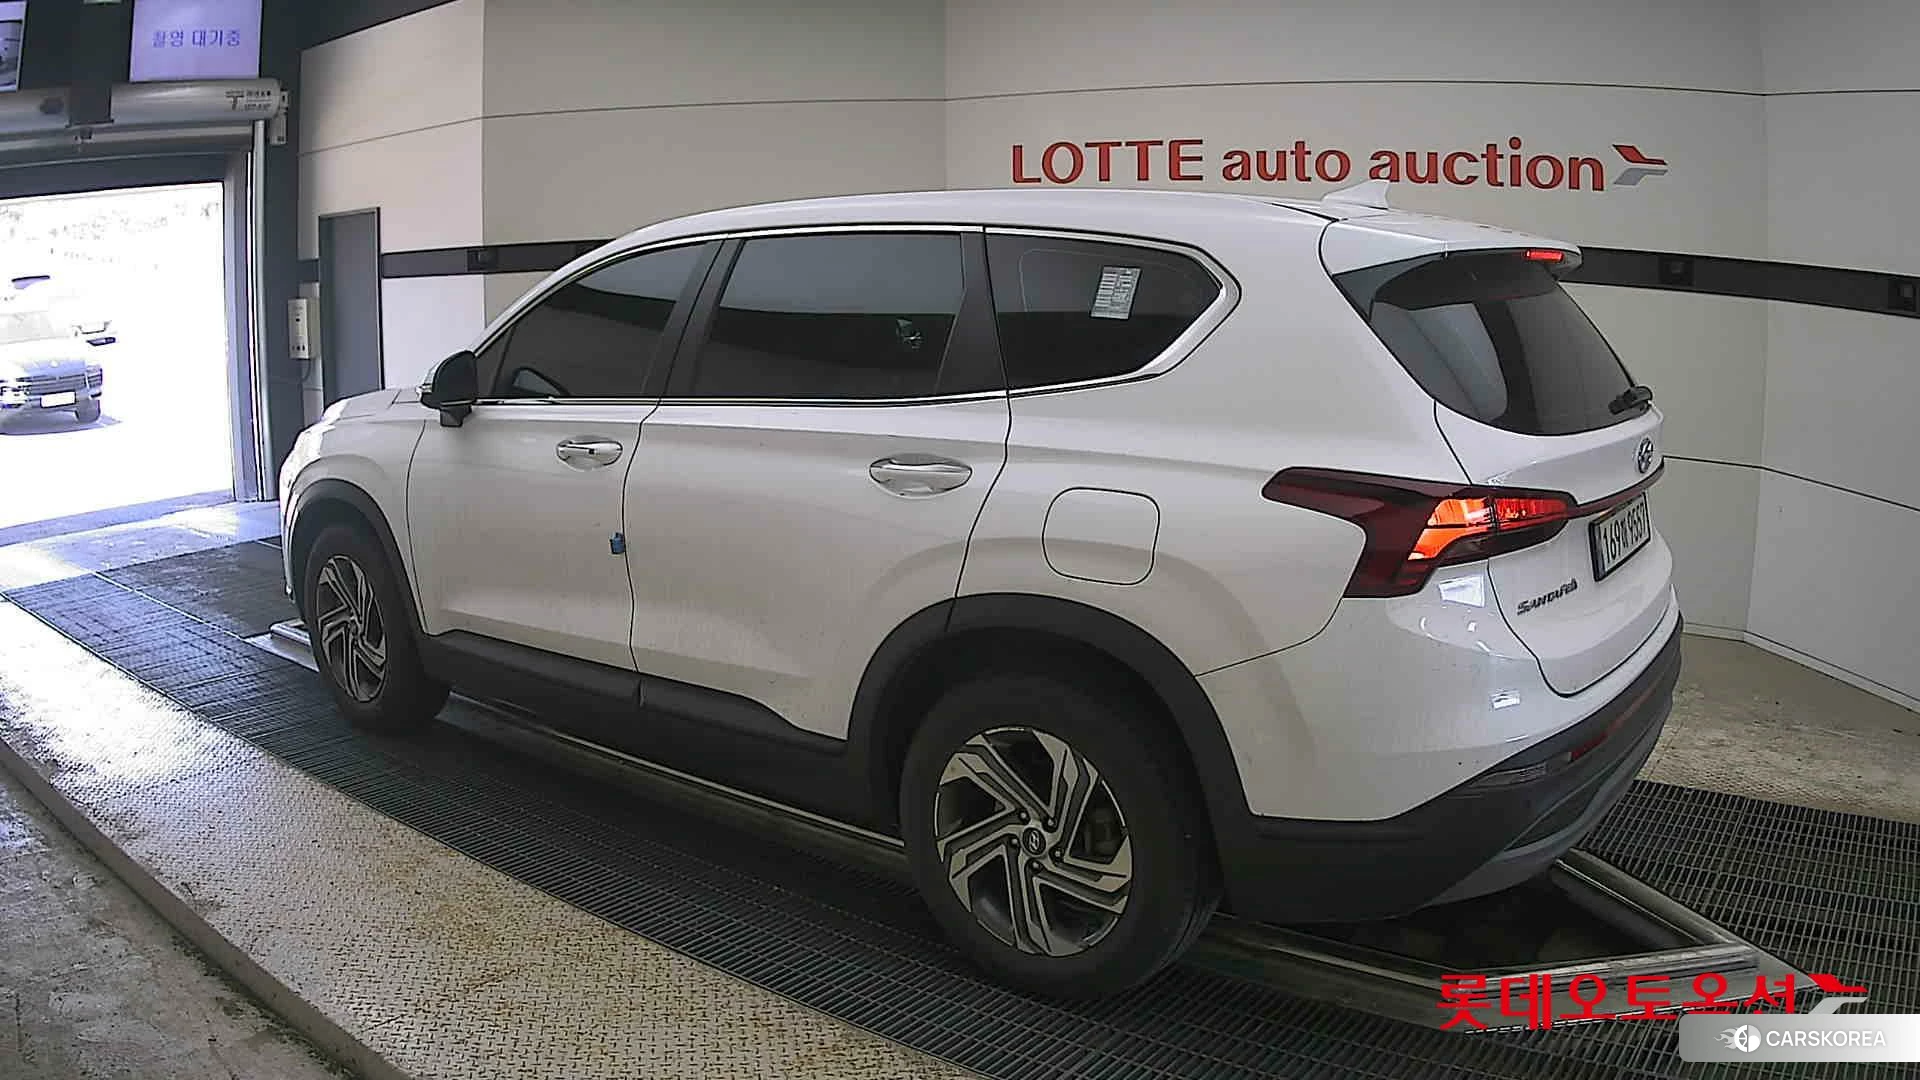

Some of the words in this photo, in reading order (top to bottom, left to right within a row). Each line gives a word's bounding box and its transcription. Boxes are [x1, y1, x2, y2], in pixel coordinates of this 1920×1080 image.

[192, 28, 241, 48] 대기중
[1012, 139, 1203, 184] LOTTE
[1222, 140, 1351, 182] auto
[1369, 136, 1604, 191] auction
